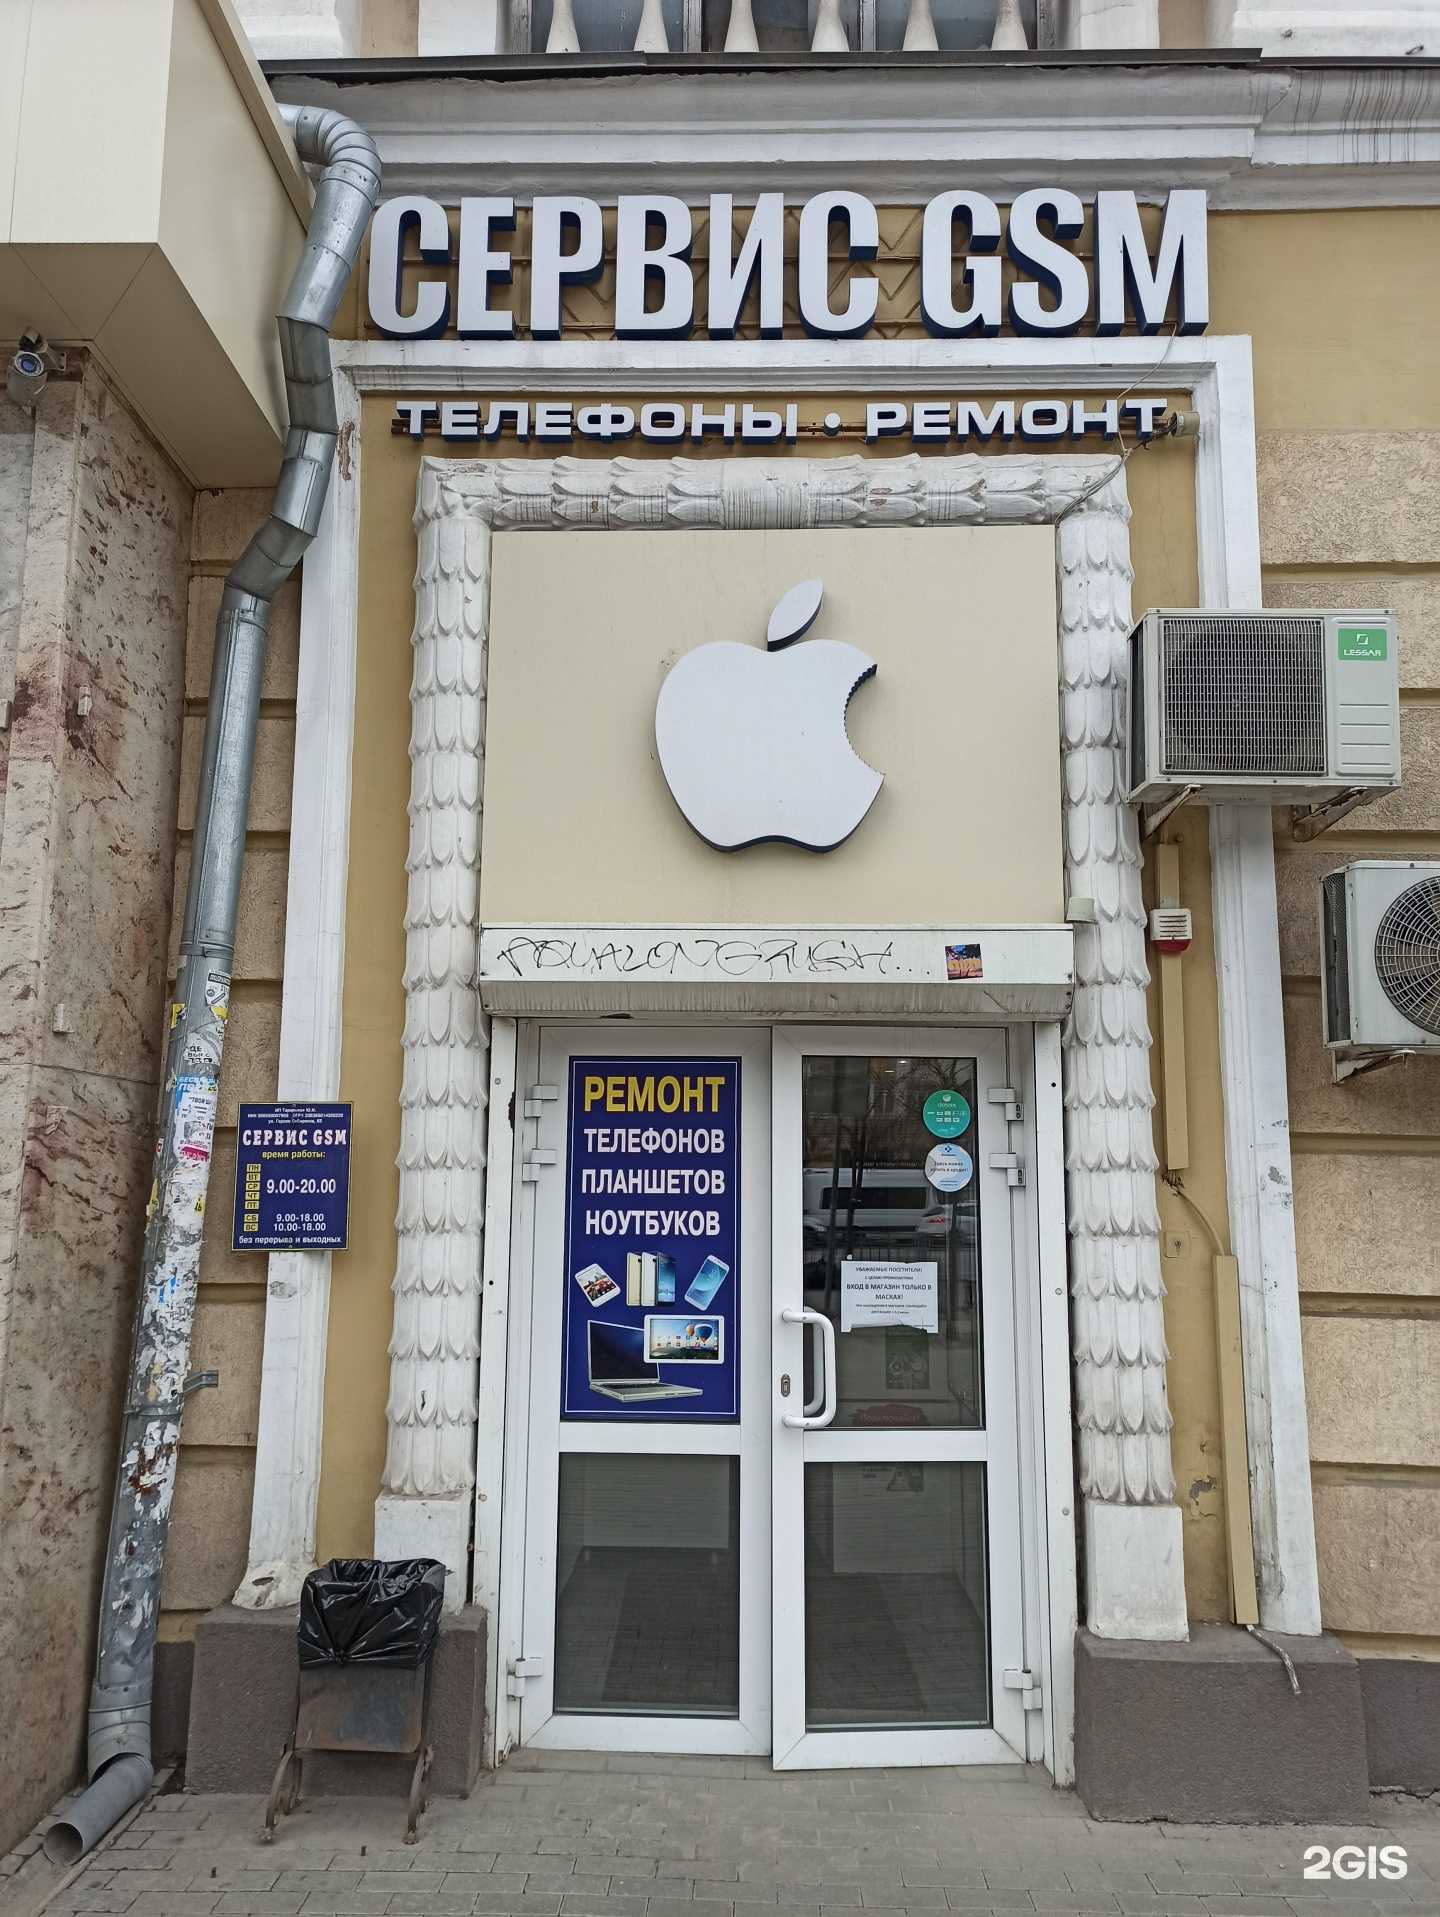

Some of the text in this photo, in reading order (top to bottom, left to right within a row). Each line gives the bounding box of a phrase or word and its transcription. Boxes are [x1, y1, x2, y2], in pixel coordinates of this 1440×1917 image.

[368, 188, 1210, 340] СЕРВИС GSM
[396, 399, 1168, 445] ТЕЛЕФОНЫ РЕМОНТ
[1343, 649, 1382, 657] LESSAR
[584, 1076, 725, 1112] РЕМОНТ
[242, 1129, 347, 1146] СЕРВИС GSM
[584, 1127, 725, 1153] ТЕЛЕФОНОВ
[262, 1149, 326, 1159] время работы:
[266, 1179, 337, 1194] 9.00-20.00
[581, 1169, 726, 1194] ПЛАНШЕТОВ
[273, 1223, 327, 1232] 10.00-18.00
[276, 1213, 324, 1222] 9.00-18.00
[586, 1210, 721, 1236] НОУТБУКОВ
